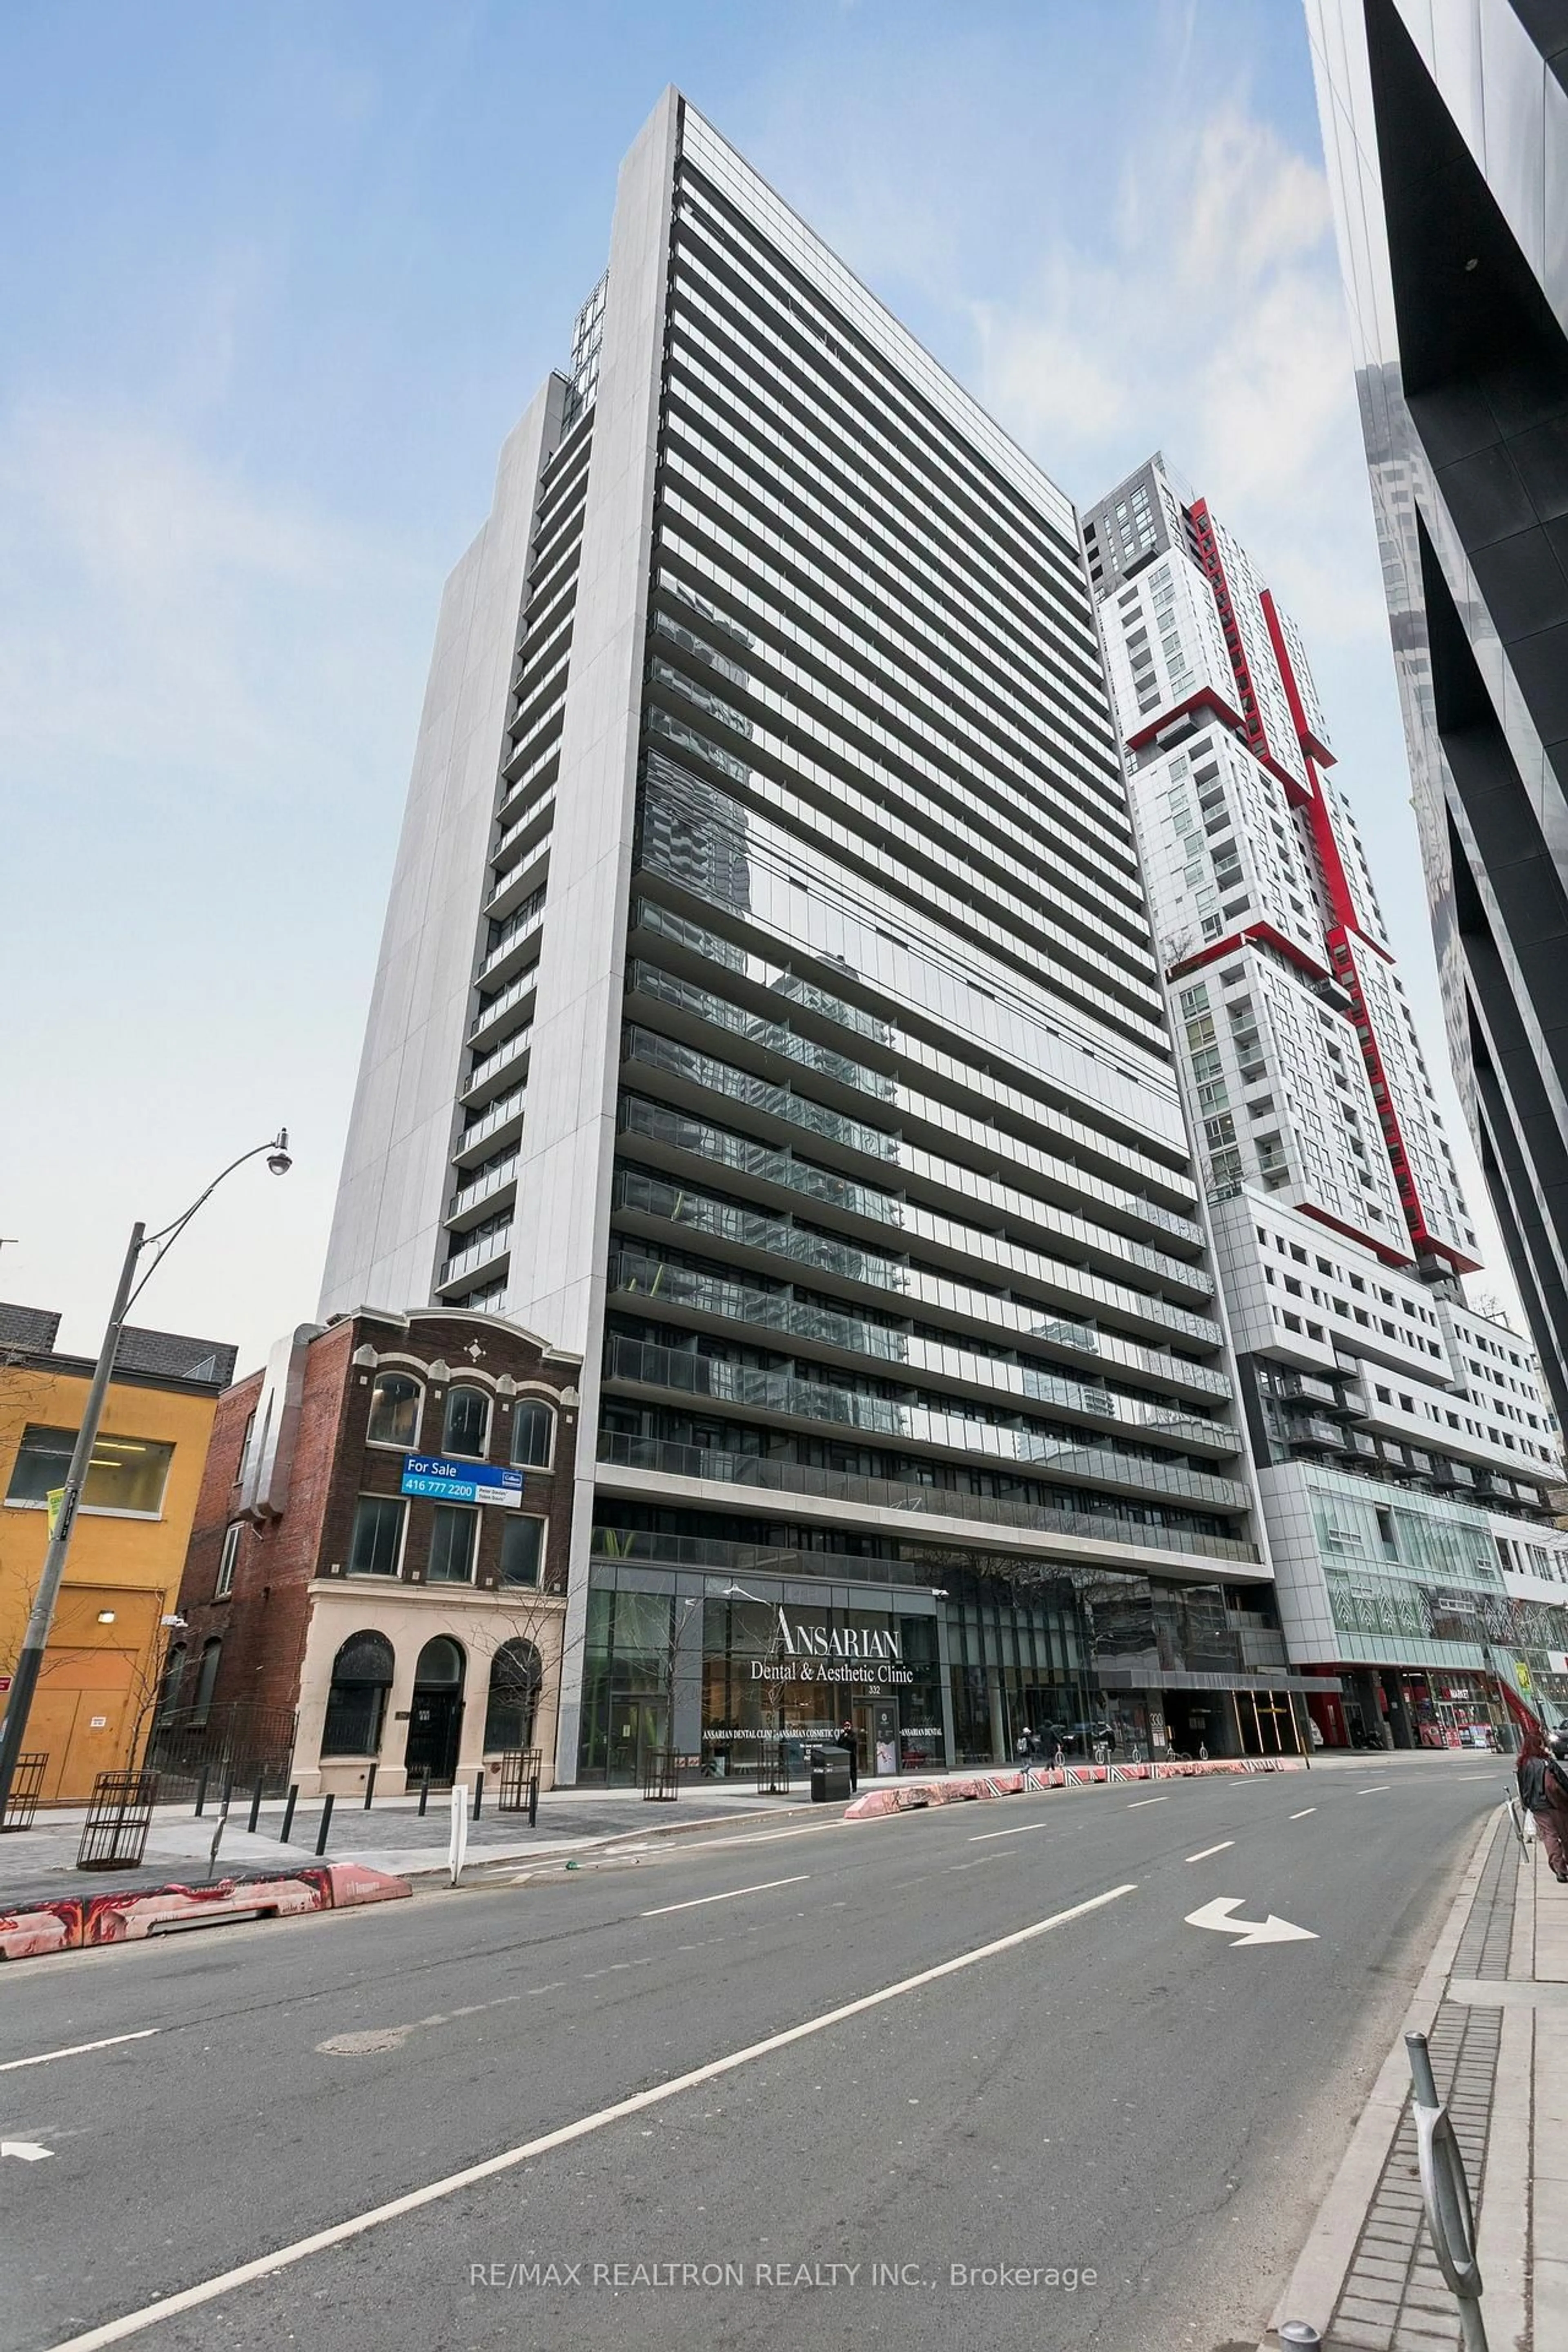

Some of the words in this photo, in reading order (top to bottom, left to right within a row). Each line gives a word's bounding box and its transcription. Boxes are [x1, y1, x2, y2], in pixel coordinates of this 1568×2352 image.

[408, 1459, 428, 1472] For
[432, 1462, 457, 1477] Sale
[406, 1479, 425, 1490] 416
[428, 1482, 445, 1493] 777
[449, 1484, 472, 1496] 2200
[770, 1606, 902, 1658] ANSARIAN
[751, 1660, 796, 1680] Dental
[801, 1661, 814, 1681] &
[817, 1663, 874, 1682] Aesthetic
[878, 1664, 913, 1683] Clinic
[869, 1685, 880, 1695] 332
[702, 1729, 733, 1739] ANSARIAN
[733, 1729, 756, 1739] DENTAL
